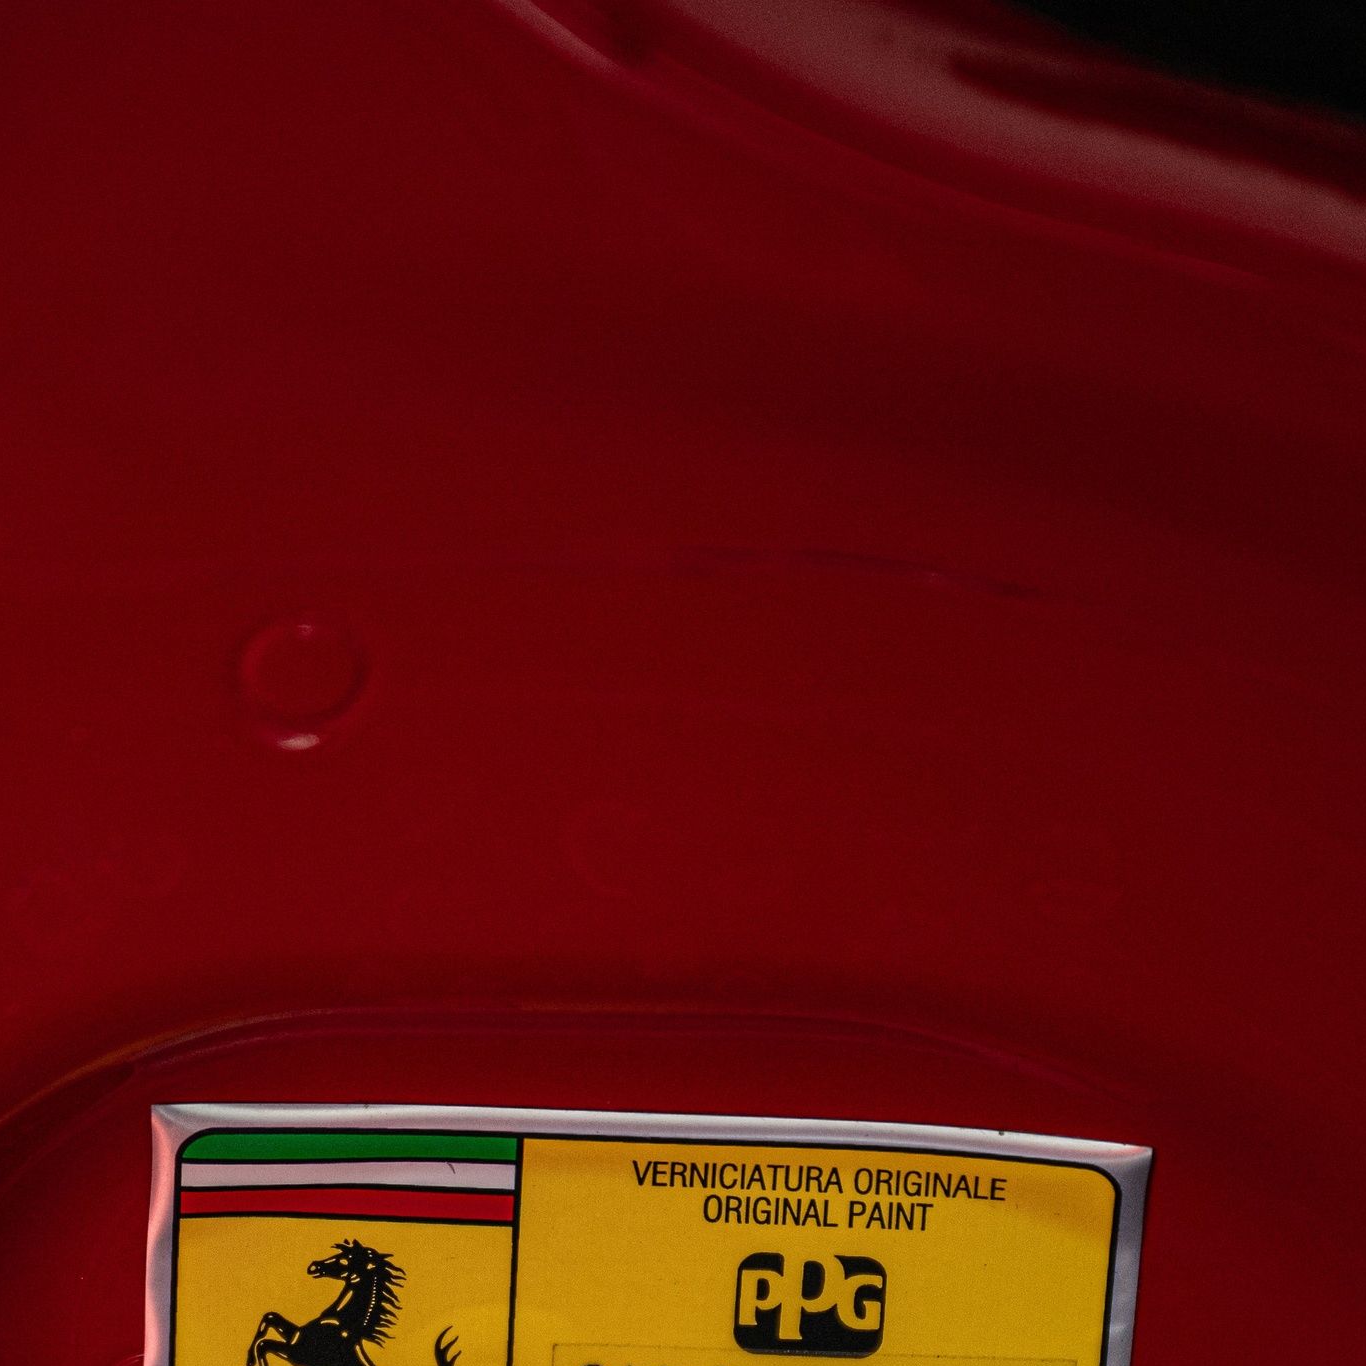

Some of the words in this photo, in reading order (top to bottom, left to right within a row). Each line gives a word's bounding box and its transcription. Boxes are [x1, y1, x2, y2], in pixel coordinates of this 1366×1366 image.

[632, 1160, 843, 1195] VERNICIATURA
[854, 1168, 1008, 1202] ORIGINALE
[703, 1194, 838, 1228] ORIGINAL
[848, 1201, 934, 1232] PAINT
[736, 1252, 885, 1342] PPG
